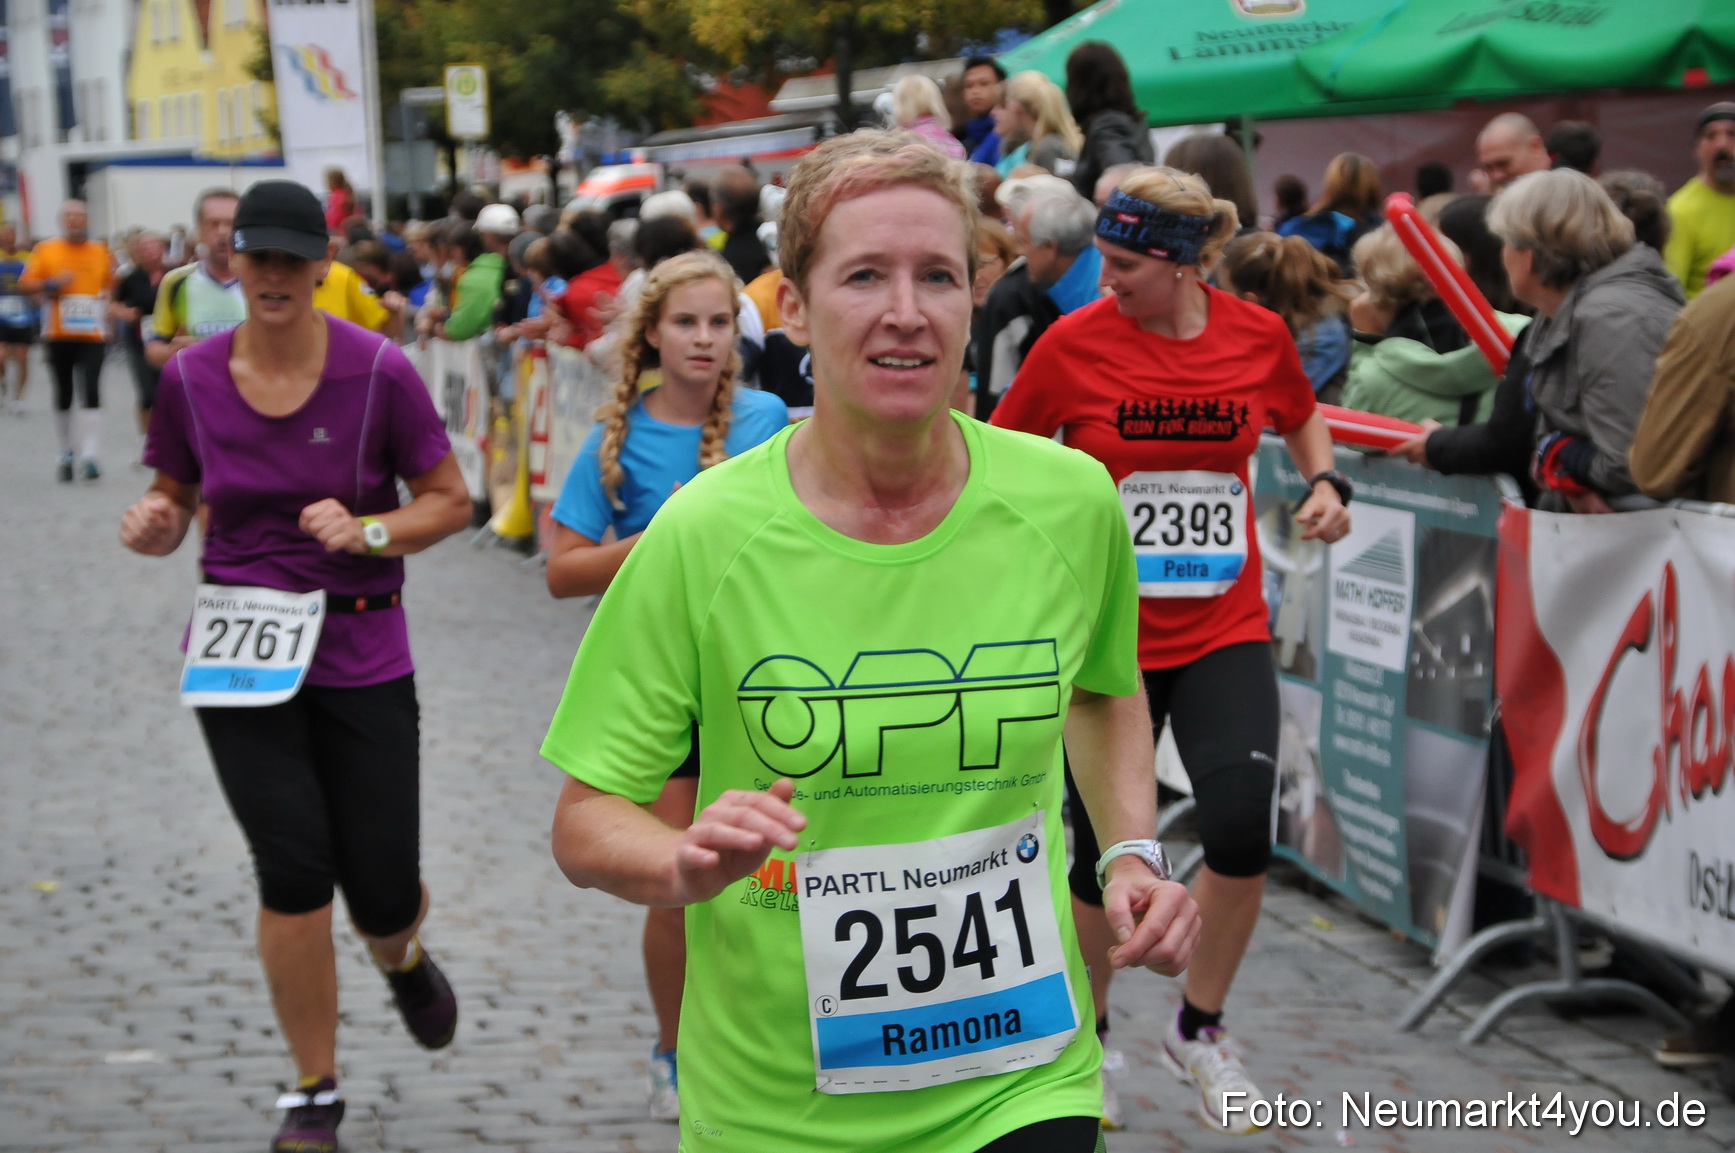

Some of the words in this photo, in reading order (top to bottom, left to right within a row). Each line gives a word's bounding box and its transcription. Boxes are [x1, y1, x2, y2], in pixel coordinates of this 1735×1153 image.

[1123, 419, 1155, 435] RUN
[1157, 417, 1186, 436] FOR
[1123, 484, 1166, 494] PARTL
[1169, 483, 1226, 494] Neumarkt
[1133, 502, 1233, 546] 2393
[1164, 560, 1209, 577] Petra
[198, 597, 240, 611] PARTL
[242, 600, 303, 616] Neumarkt
[200, 616, 306, 661] 2761
[228, 673, 256, 690] Iris
[814, 787, 841, 800] und
[843, 776, 1018, 798] Automatisierungstechnik
[805, 871, 896, 898] PARTL
[903, 848, 1009, 890] Neumarkt
[834, 878, 1035, 1001] 2541
[882, 1008, 1022, 1056] Ramona
